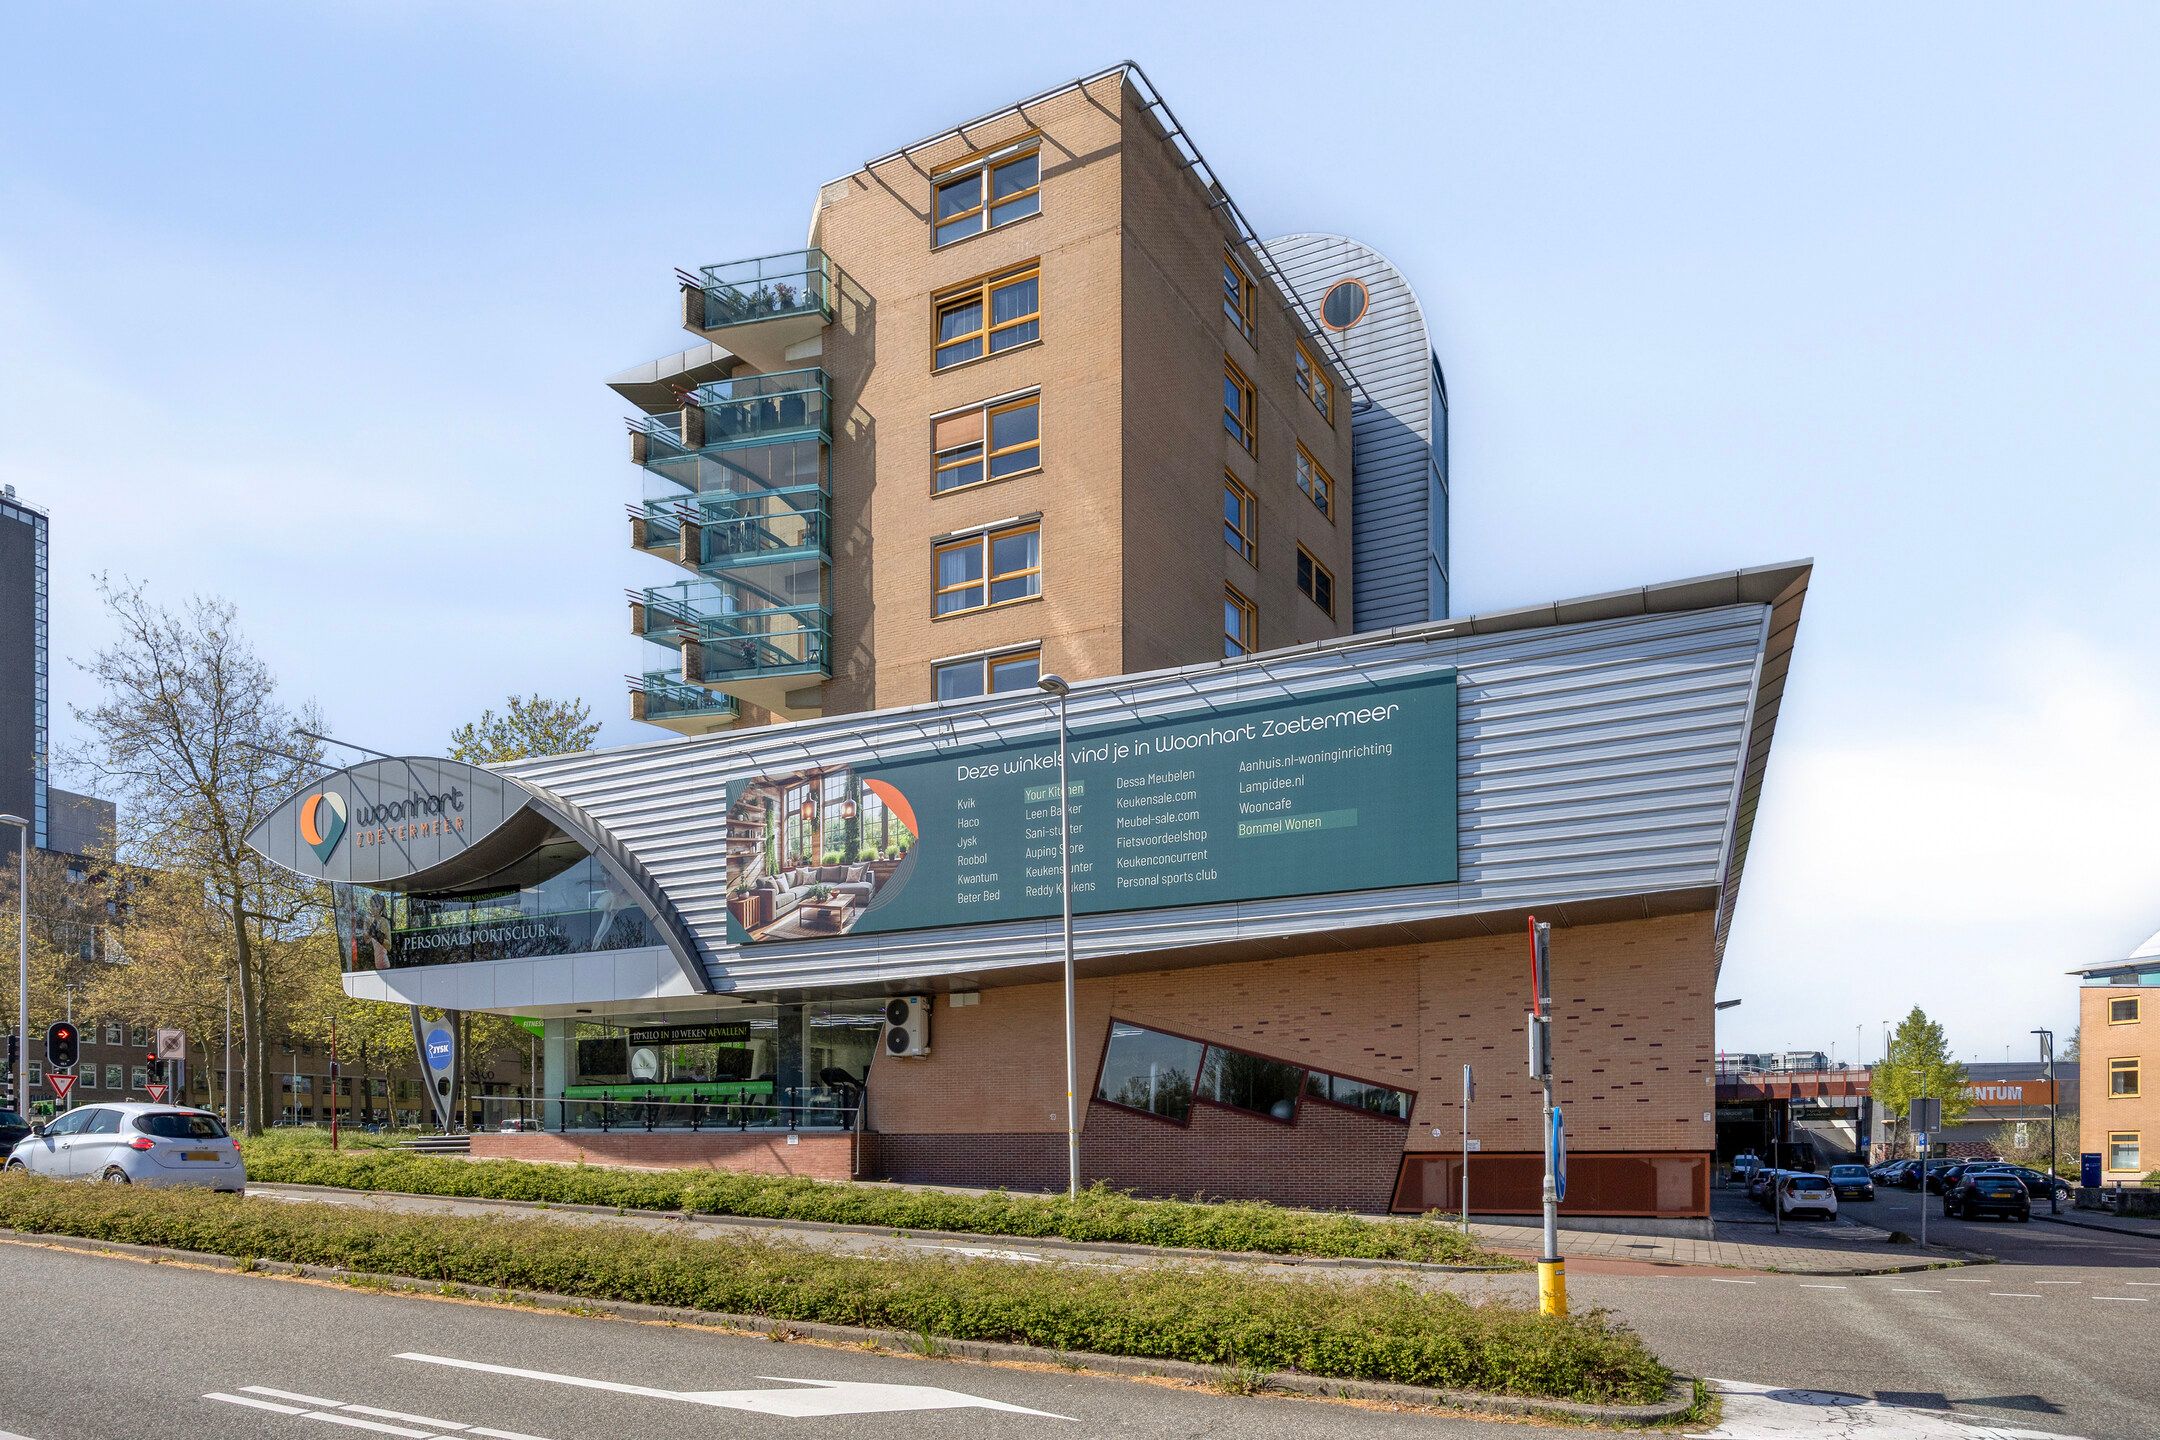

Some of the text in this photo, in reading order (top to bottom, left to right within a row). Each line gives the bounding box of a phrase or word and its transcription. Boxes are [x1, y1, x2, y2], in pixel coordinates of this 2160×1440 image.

[957, 704, 1399, 781] Deze winkels vind je in Woonhart Zoetermeer
[1239, 742, 1393, 772] Aanhuis.nl-woninginrichting
[1116, 770, 1195, 789] Dessa Meubelen
[1239, 774, 1305, 794] Lampidee.nl
[1026, 785, 1084, 801] Your Kiten
[1116, 790, 1197, 809] Keukensale.com
[356, 786, 464, 827] woonhart
[957, 798, 976, 810] Kvik
[1025, 804, 1083, 820] Leen Baker
[1239, 797, 1292, 814] Wooncafe
[957, 817, 980, 829] Haco
[1116, 810, 1200, 828] Meubel-sale.com
[1238, 817, 1322, 836] Bommel Wonen
[356, 816, 464, 848] ZOETERMEER
[1025, 823, 1083, 840] Sani-stuter
[1116, 830, 1208, 848] Fietsvoordeelshop
[957, 835, 978, 850] Jysk
[957, 853, 987, 866] Roobol
[1025, 843, 1085, 860] Auping Sore
[1117, 850, 1208, 869] Keukenconcurrent
[957, 872, 998, 885] Kwantum
[1026, 862, 1093, 878] Keukensnter
[1117, 868, 1217, 888] Personal sports club
[957, 890, 1000, 904] Beter Bed
[1026, 882, 1096, 898] Reddy Kkens
[404, 923, 561, 951] PERSONALSPORTSCLUB.NL
[523, 1020, 545, 1028] FITNESS
[641, 1031, 659, 1040] KILO
[672, 1030, 680, 1038] 10
[680, 1028, 707, 1038] WEKEN
[708, 1026, 748, 1037] AFVALLEN!
[432, 1044, 449, 1055] JYSK
[1960, 1086, 2022, 1100] ANTUM
